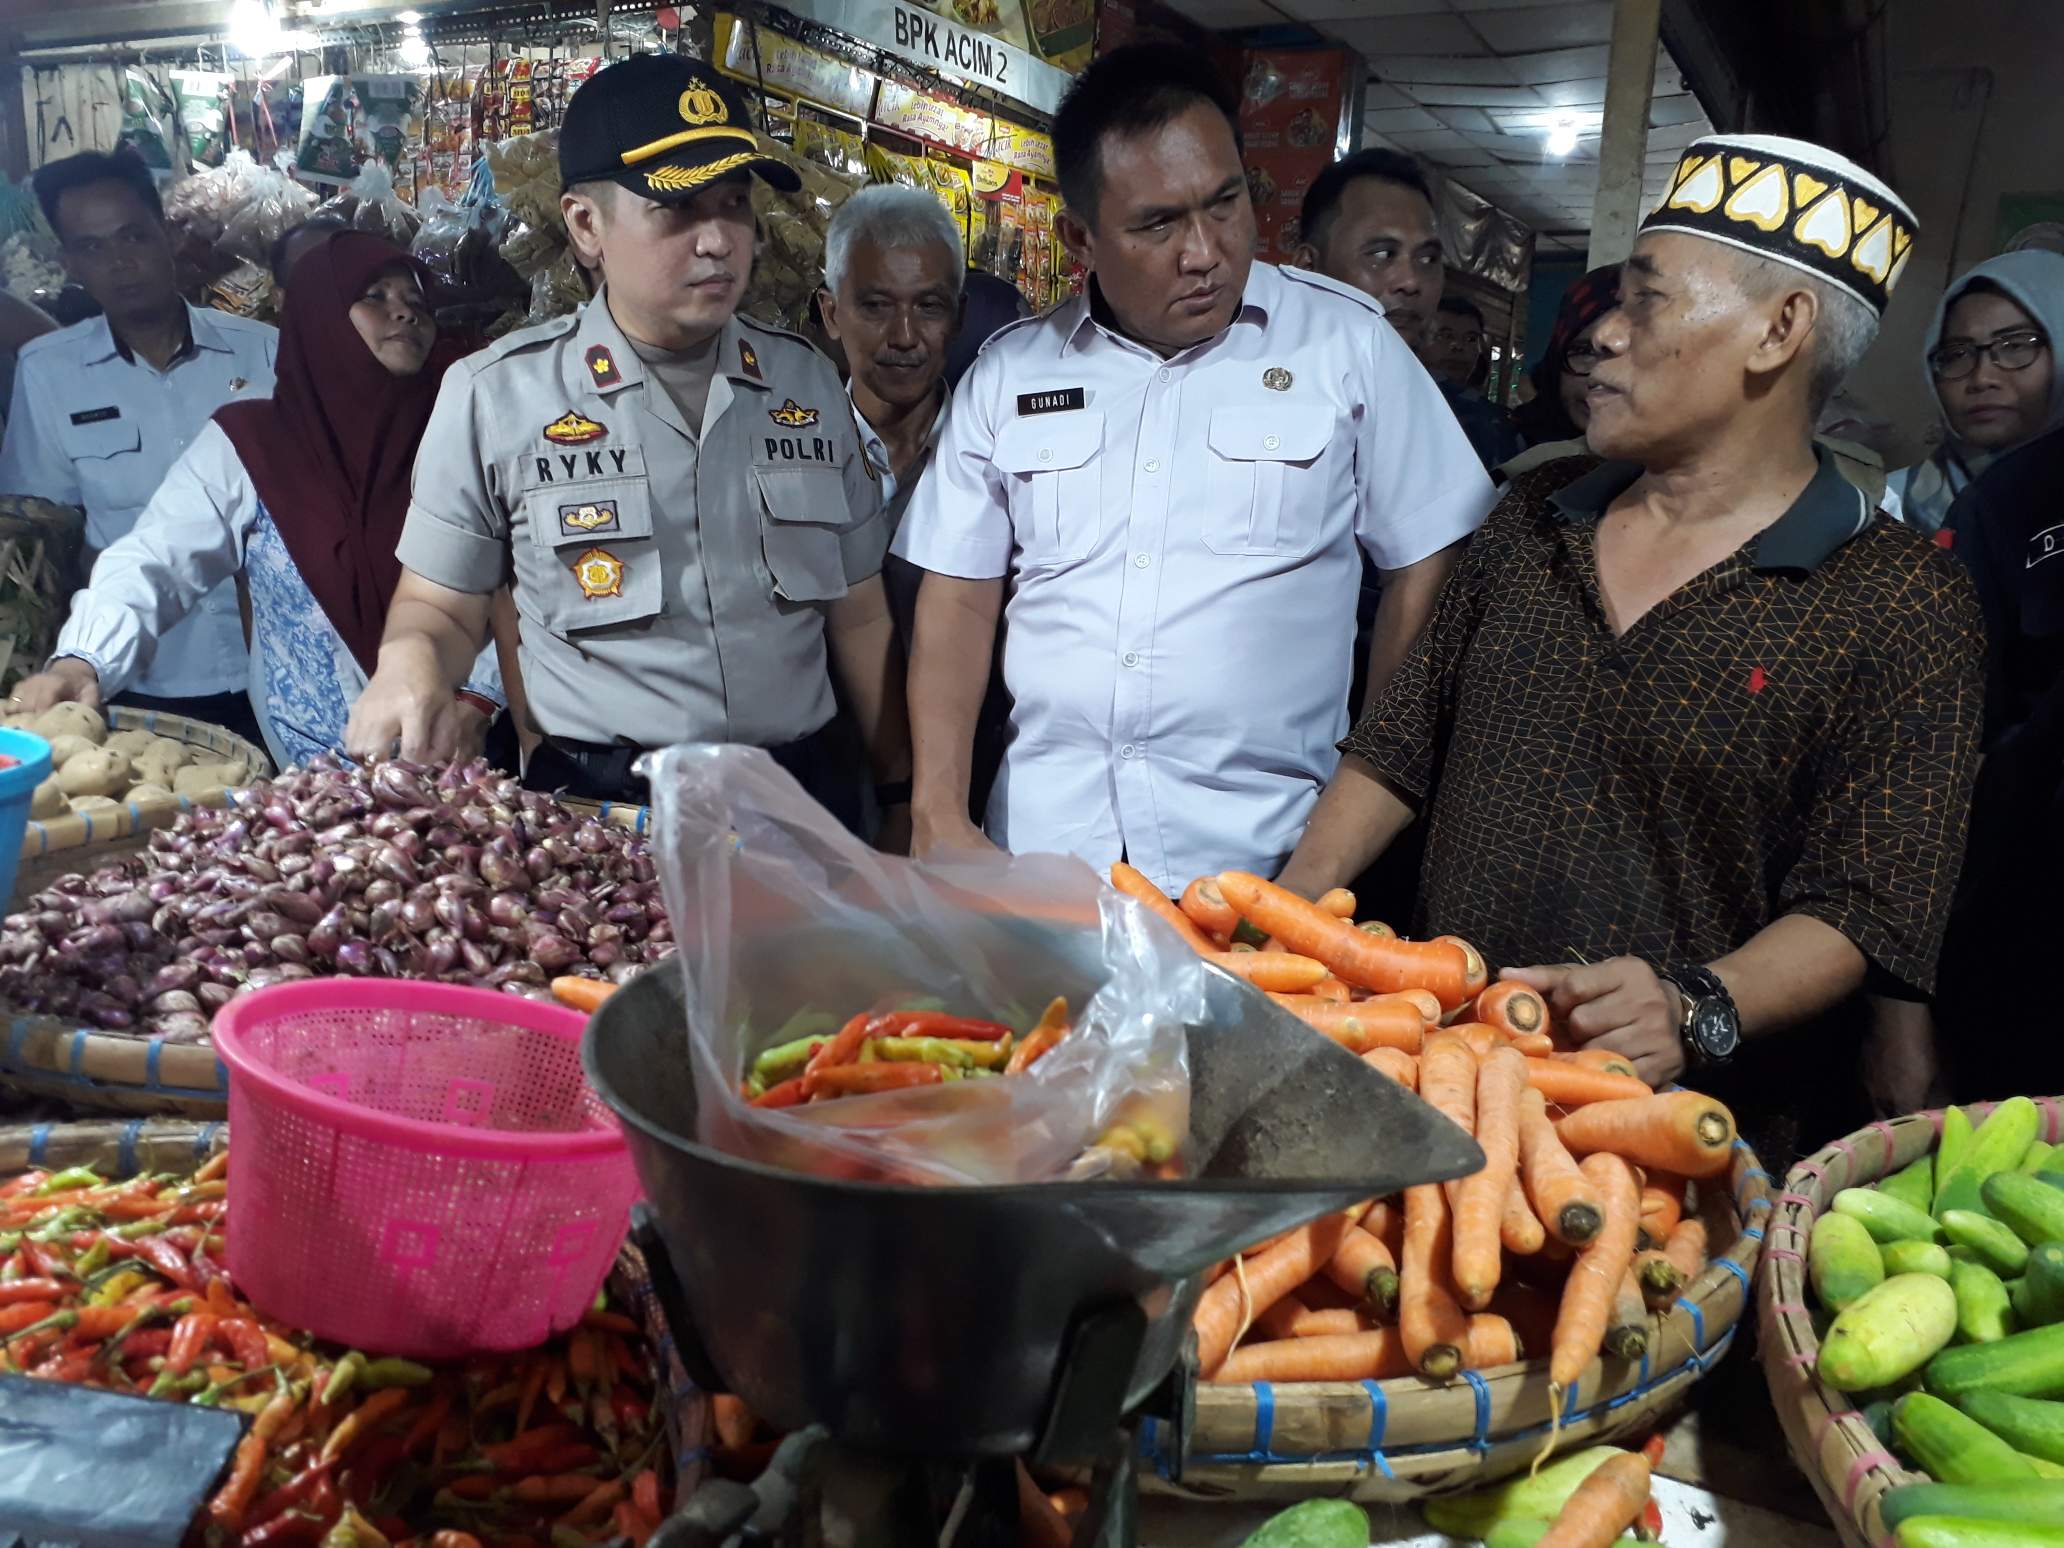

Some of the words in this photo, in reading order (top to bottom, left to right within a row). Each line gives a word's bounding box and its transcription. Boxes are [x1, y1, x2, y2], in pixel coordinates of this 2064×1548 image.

[895, 6, 939, 58] BPK
[944, 29, 993, 79] ACIM
[995, 52, 1008, 84] 2
[1031, 393, 1070, 410] GUNADI
[764, 437, 834, 463] POLRI
[536, 449, 625, 483] RYKY
